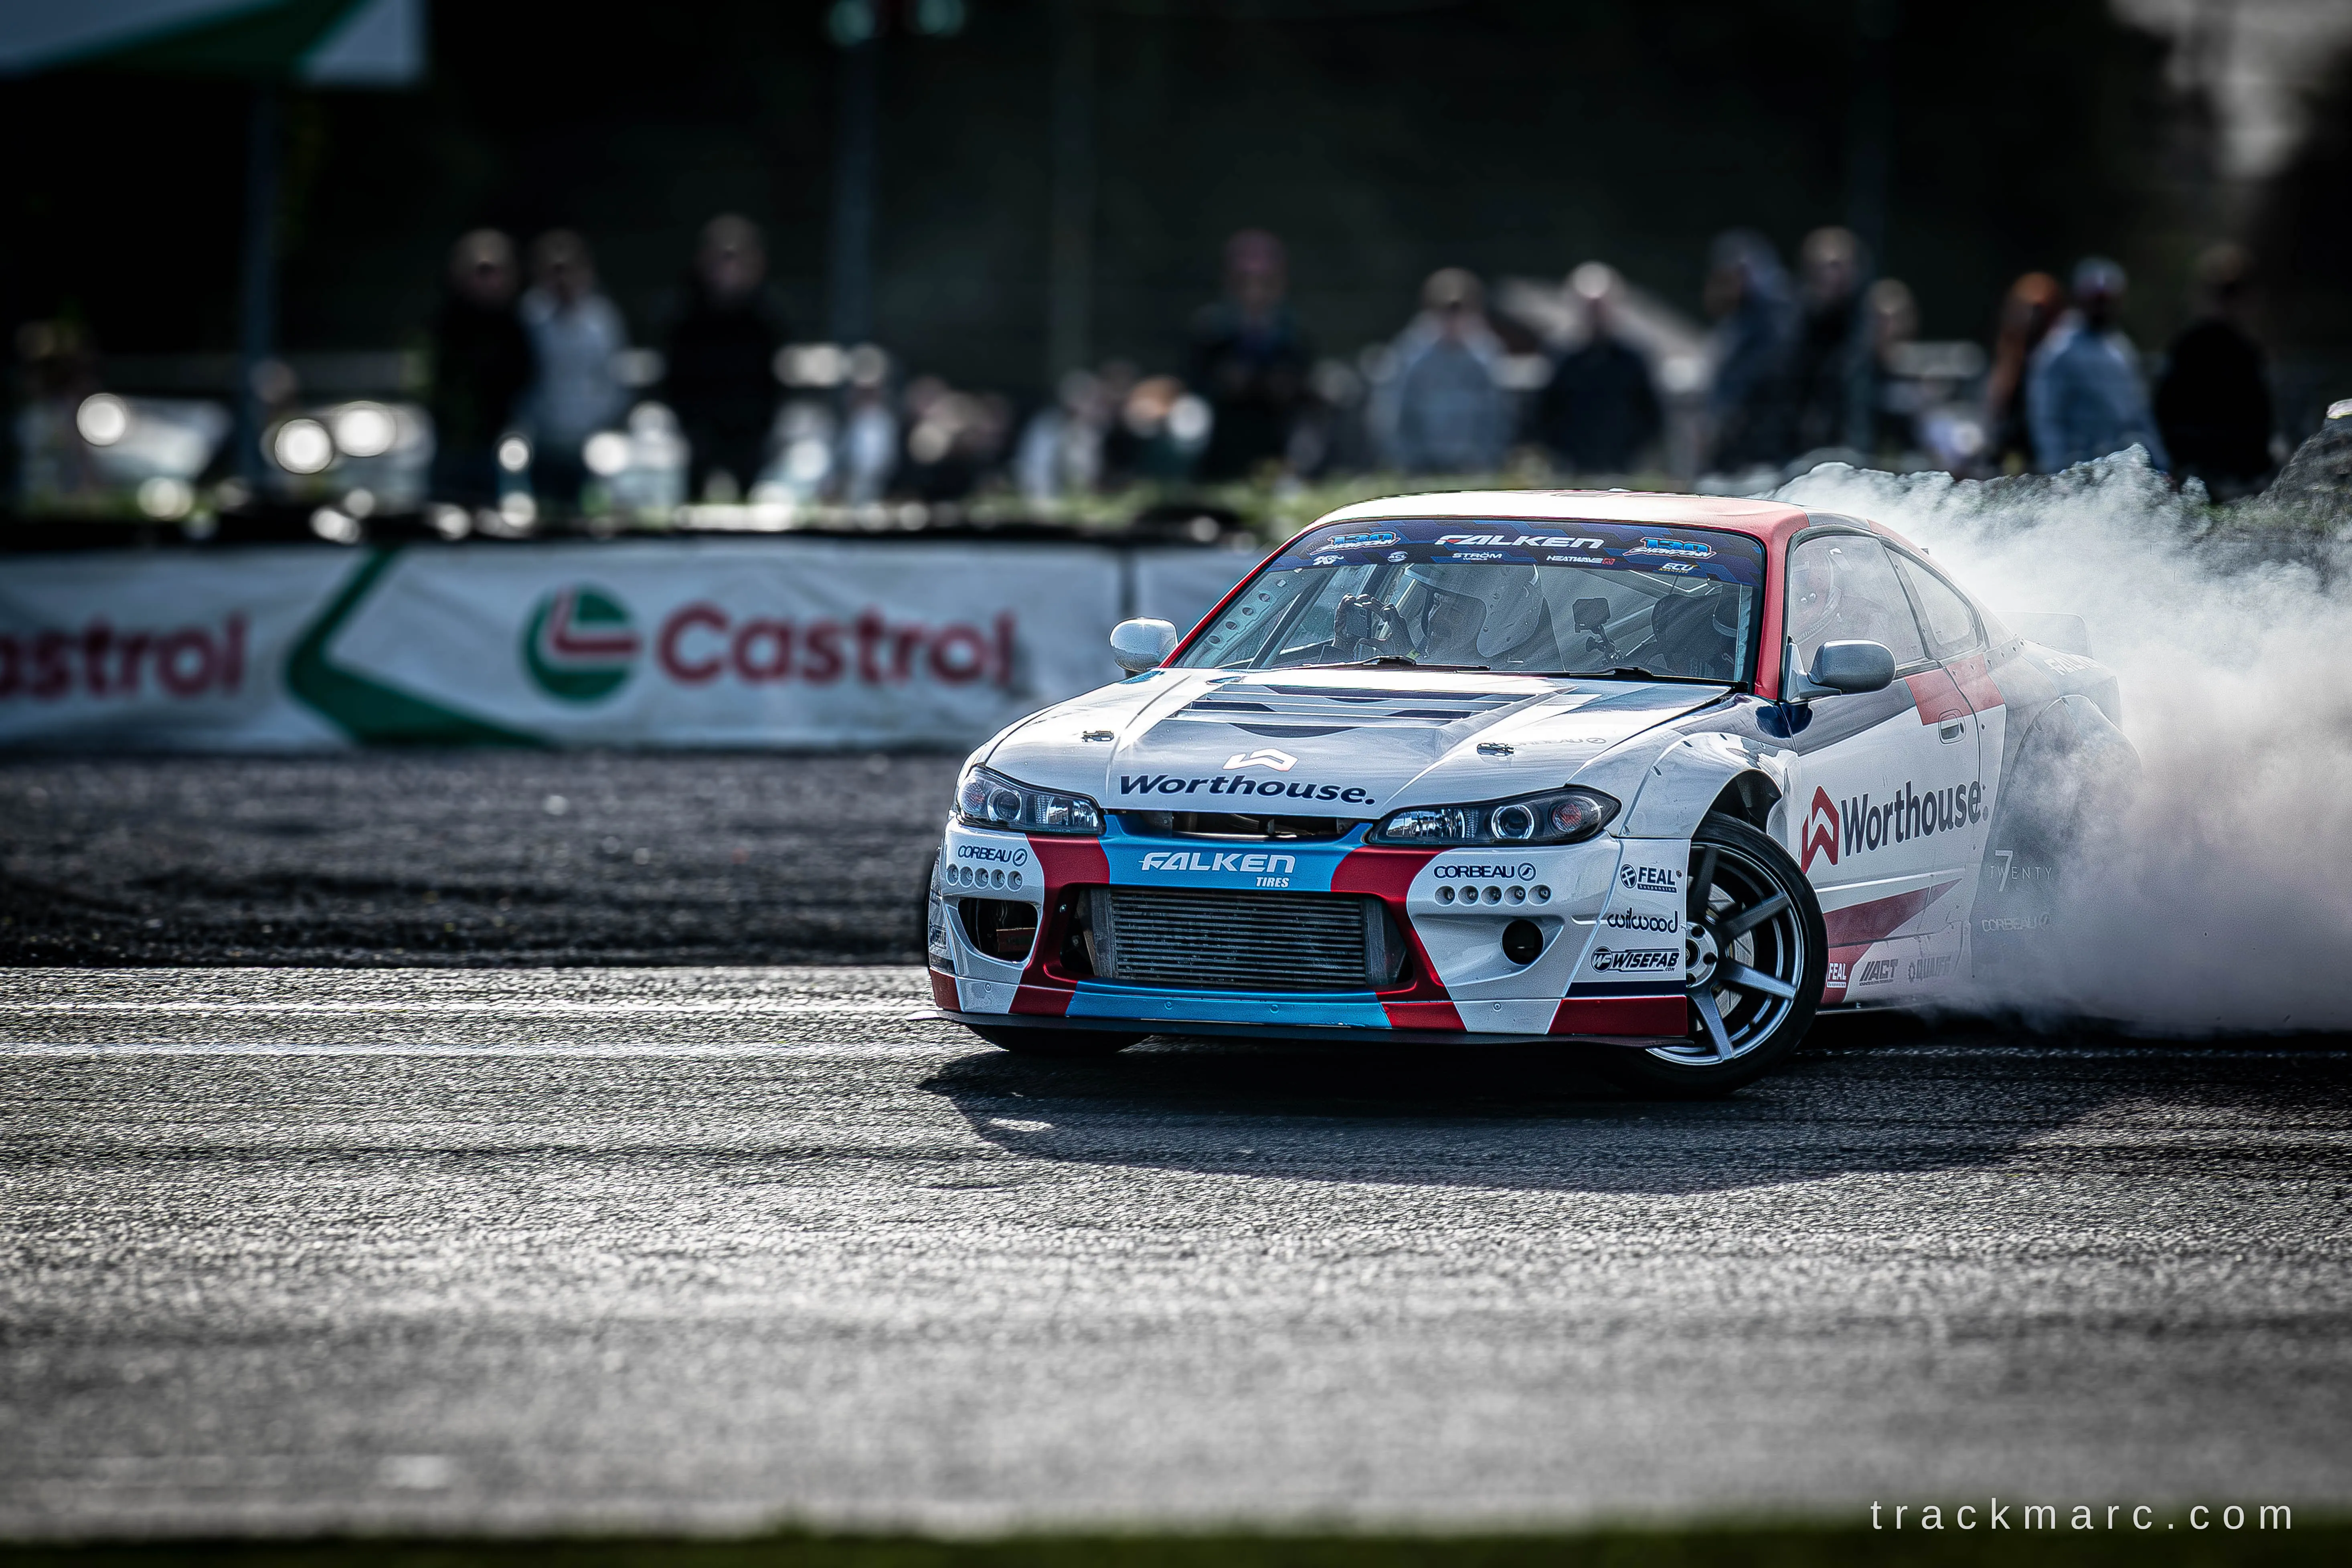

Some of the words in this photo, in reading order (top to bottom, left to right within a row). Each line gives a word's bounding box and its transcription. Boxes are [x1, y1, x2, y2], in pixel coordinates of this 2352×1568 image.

[1435, 535, 1604, 548] FALKEN
[1546, 555, 1604, 563] HEATWAVE
[1629, 547, 1712, 557] SHOWDOWN
[1662, 563, 1694, 571] ECU
[656, 602, 1017, 686] Castrol
[1121, 774, 1376, 805] Worthouse.
[958, 845, 1012, 862] CORBEAU
[1138, 852, 1295, 873] FALKEN
[1434, 865, 1514, 878] CORBEAU
[1638, 866, 1676, 886] FEAL
[1256, 877, 1289, 887] TIRES
[1607, 907, 1678, 933] wilwood
[1613, 953, 1680, 968] WISEFAB
[1828, 963, 1847, 980] FEAL
